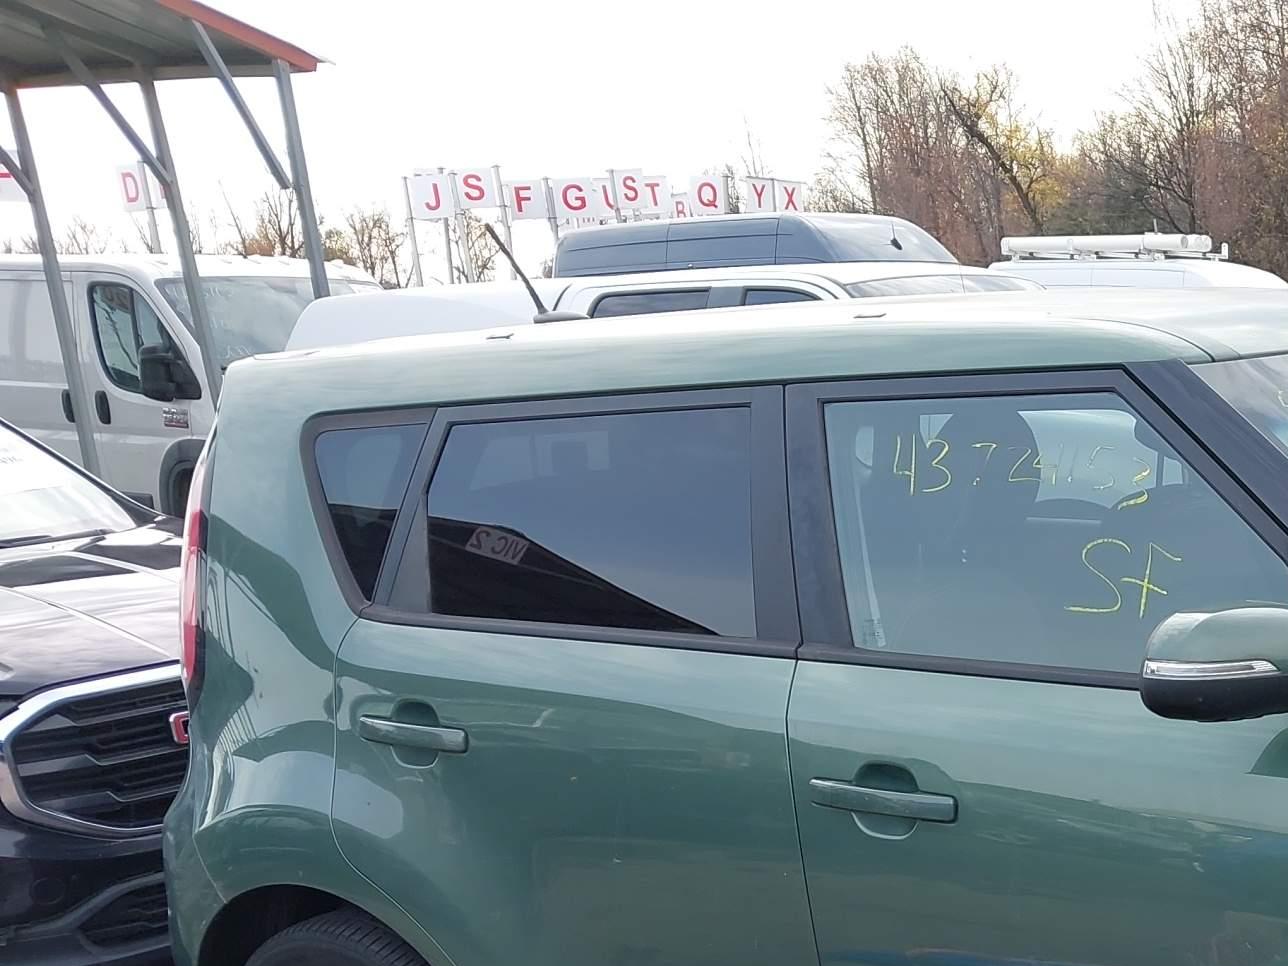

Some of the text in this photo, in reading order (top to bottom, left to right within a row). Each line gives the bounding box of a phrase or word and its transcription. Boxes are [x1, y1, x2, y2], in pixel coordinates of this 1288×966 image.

[120, 171, 140, 203] D
[423, 182, 442, 212] J
[462, 173, 486, 201] S
[514, 185, 533, 213] F
[561, 183, 588, 211] G
[622, 175, 639, 202] S
[644, 182, 661, 207] T
[696, 181, 720, 210] Q
[751, 182, 768, 209] Y
[782, 186, 799, 212] X
